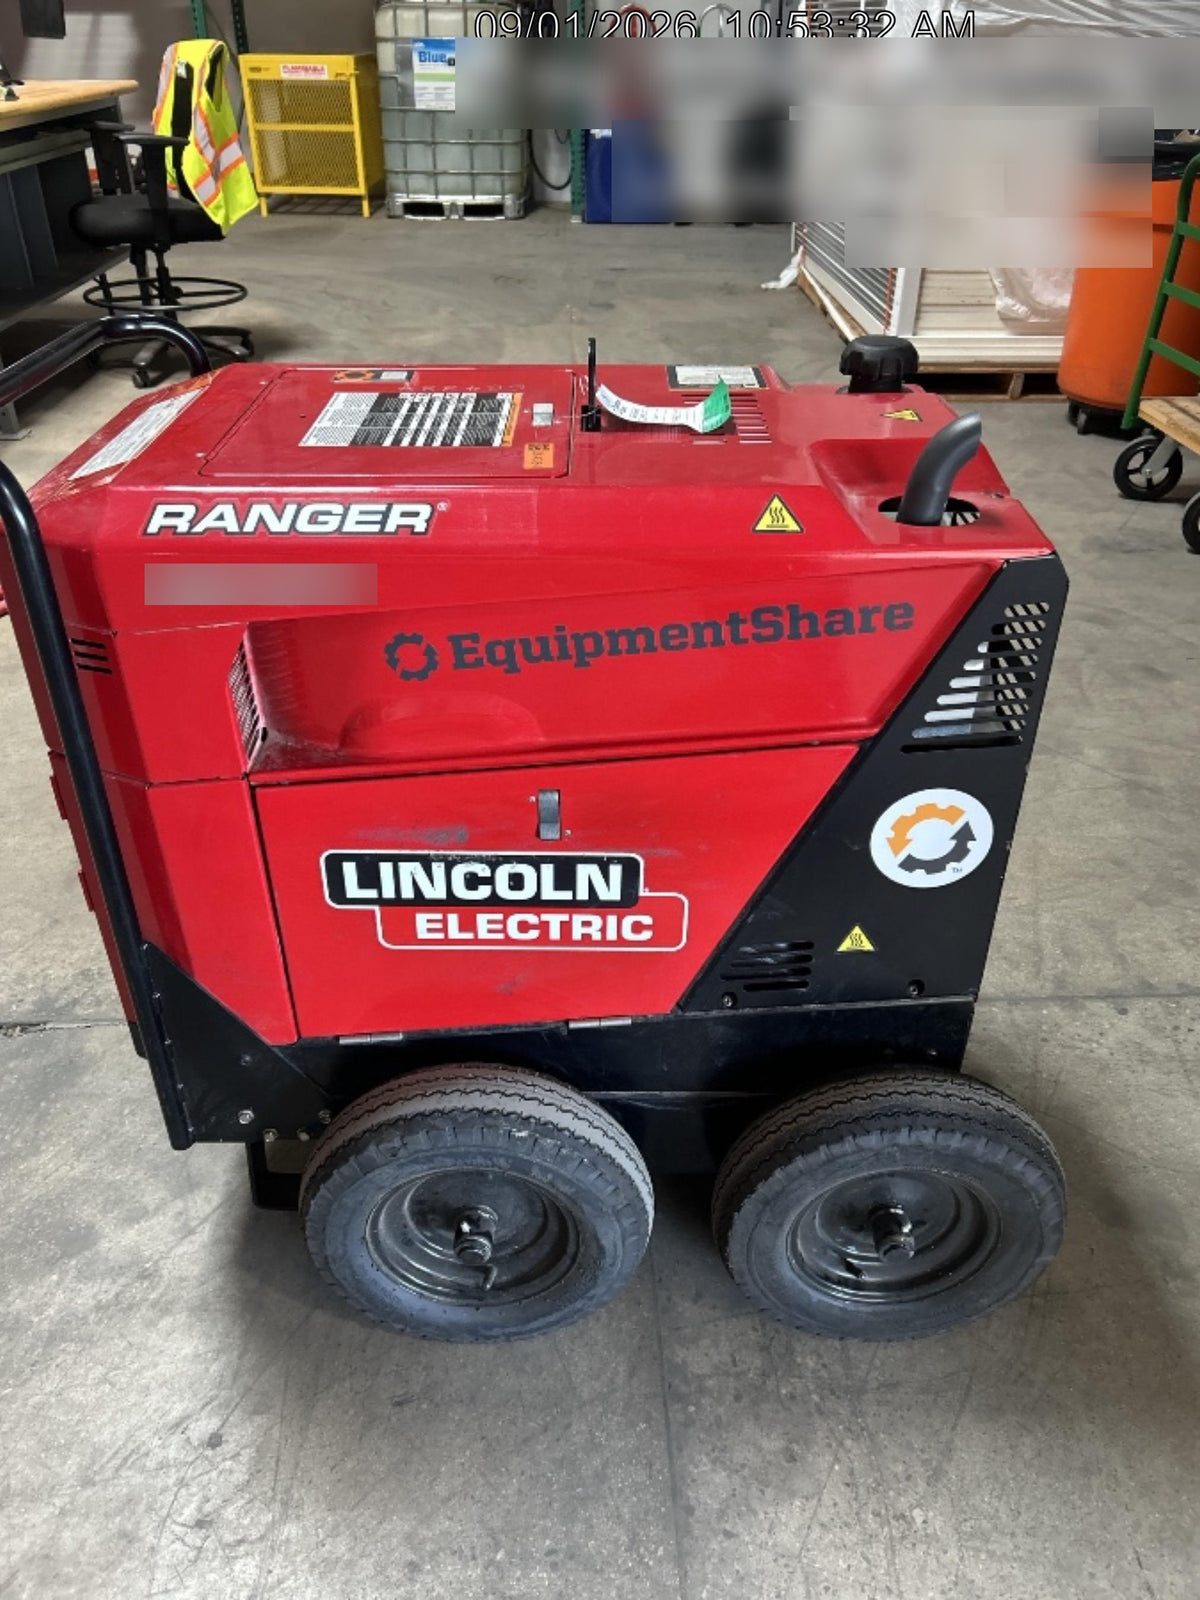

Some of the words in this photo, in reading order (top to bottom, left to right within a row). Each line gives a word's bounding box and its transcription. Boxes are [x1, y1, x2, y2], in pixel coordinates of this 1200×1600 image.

[418, 50, 447, 63] Blue
[448, 602, 915, 674] EquipmentShare
[342, 861, 623, 901] LINCOLN
[415, 912, 654, 942] ELECTRIC
